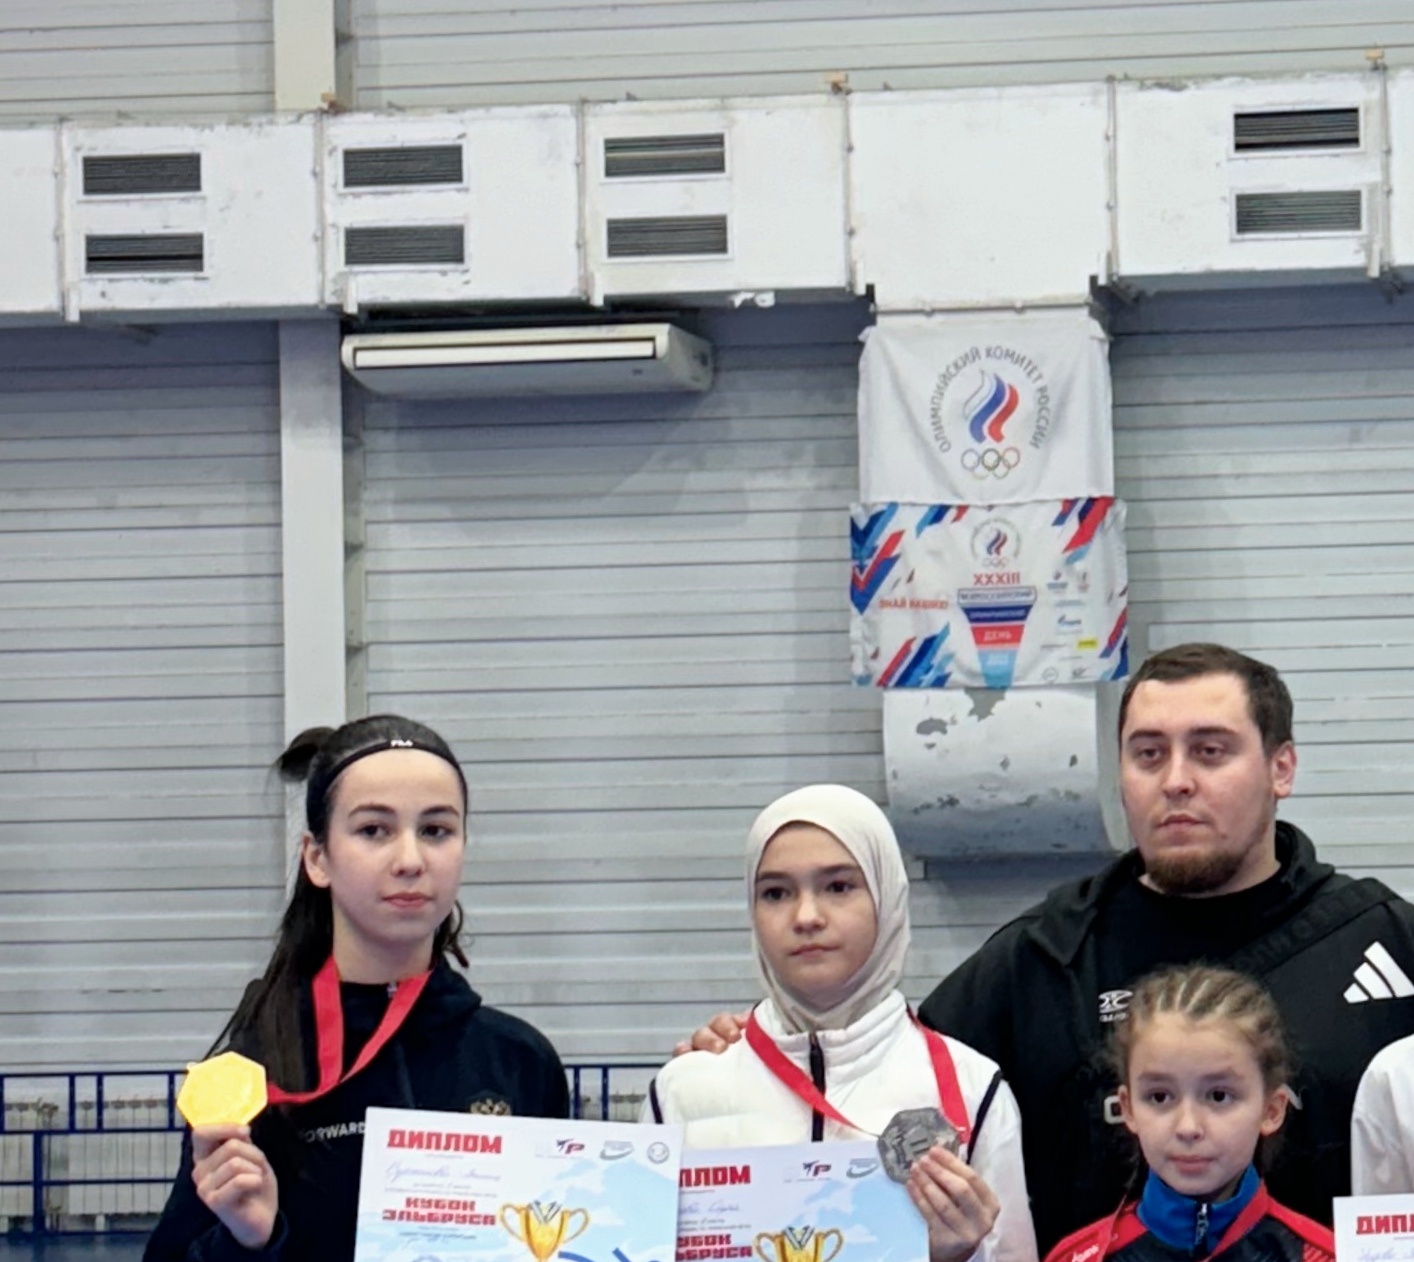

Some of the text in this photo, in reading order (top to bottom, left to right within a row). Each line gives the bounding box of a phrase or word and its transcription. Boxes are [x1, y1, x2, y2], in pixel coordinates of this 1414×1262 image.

[930, 345, 1050, 453] ОЛИМПИЙСКИЙ КОМИТЕТ РОССИИ
[973, 571, 1021, 586] XXXIII
[983, 629, 1012, 642] ДЕНЬ
[387, 1129, 502, 1154] ДИПЛОМ
[680, 1165, 751, 1188] ПЛОМ
[405, 1197, 476, 1212] КУБОК
[382, 1208, 496, 1226] ЭЛЬБРУСА
[677, 1233, 732, 1248] УБОК
[675, 1245, 753, 1262] ЬБРУСА
